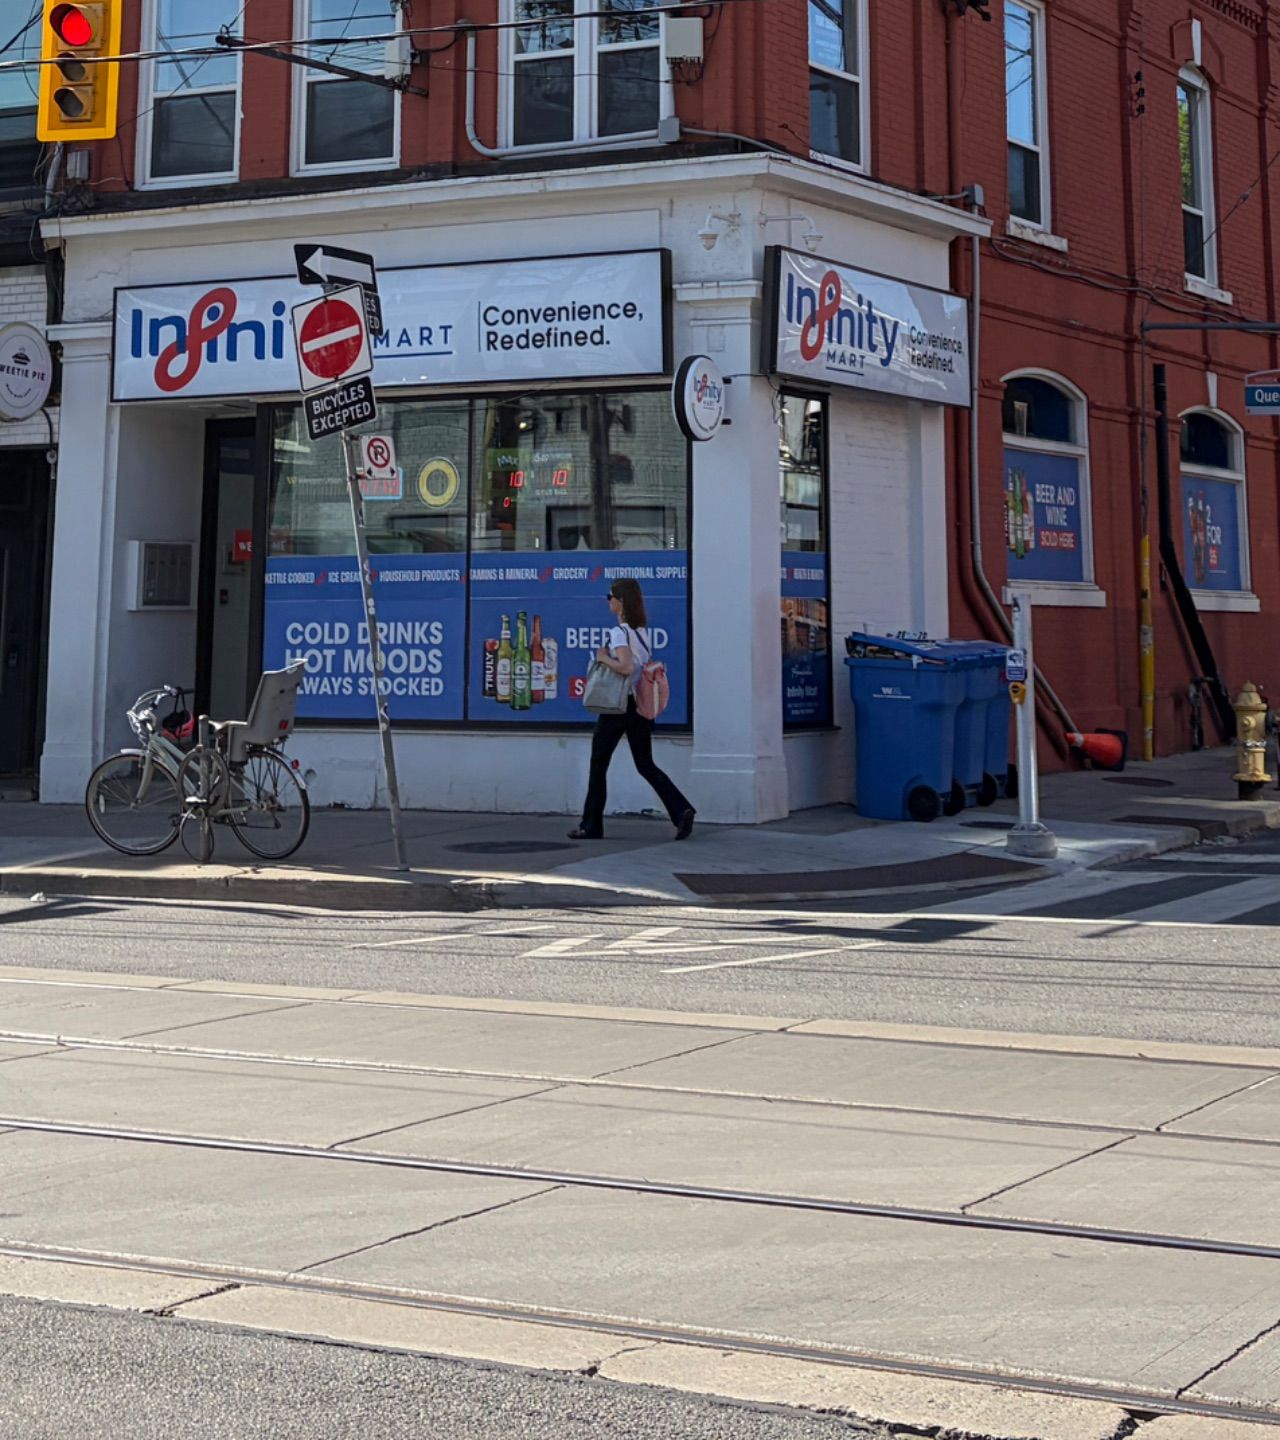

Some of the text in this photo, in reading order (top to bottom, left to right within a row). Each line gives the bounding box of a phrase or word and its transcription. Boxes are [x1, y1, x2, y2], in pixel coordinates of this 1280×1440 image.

[483, 301, 643, 327] Convenience,
[786, 269, 899, 367] Infinity
[131, 287, 286, 392] Infini
[373, 325, 453, 348] MART
[486, 325, 610, 352] Redefined.
[826, 349, 866, 369] MART
[31, 372, 46, 381] PIE
[312, 384, 366, 415] BICYCLES
[312, 403, 371, 433] EXCEPTED
[1035, 483, 1075, 506] BEER AND
[1045, 506, 1067, 526] WINE
[1041, 531, 1058, 547] SOLD
[1206, 525, 1222, 545] FOR
[265, 572, 315, 584] KETTLE COOKED
[328, 571, 339, 583] ICE
[379, 569, 460, 582] HOUSEHOLD PRODUCTS
[498, 568, 504, 580] &
[505, 568, 538, 580] MINERAL
[553, 567, 588, 580] GROCERY
[604, 566, 687, 579] NUTRITIONAL SUPPLE
[286, 621, 443, 645] COLD DRINKS
[285, 649, 442, 674] HOT MOODS
[485, 653, 495, 690] TRULY
[296, 677, 444, 696] LWAYS STOCKED
